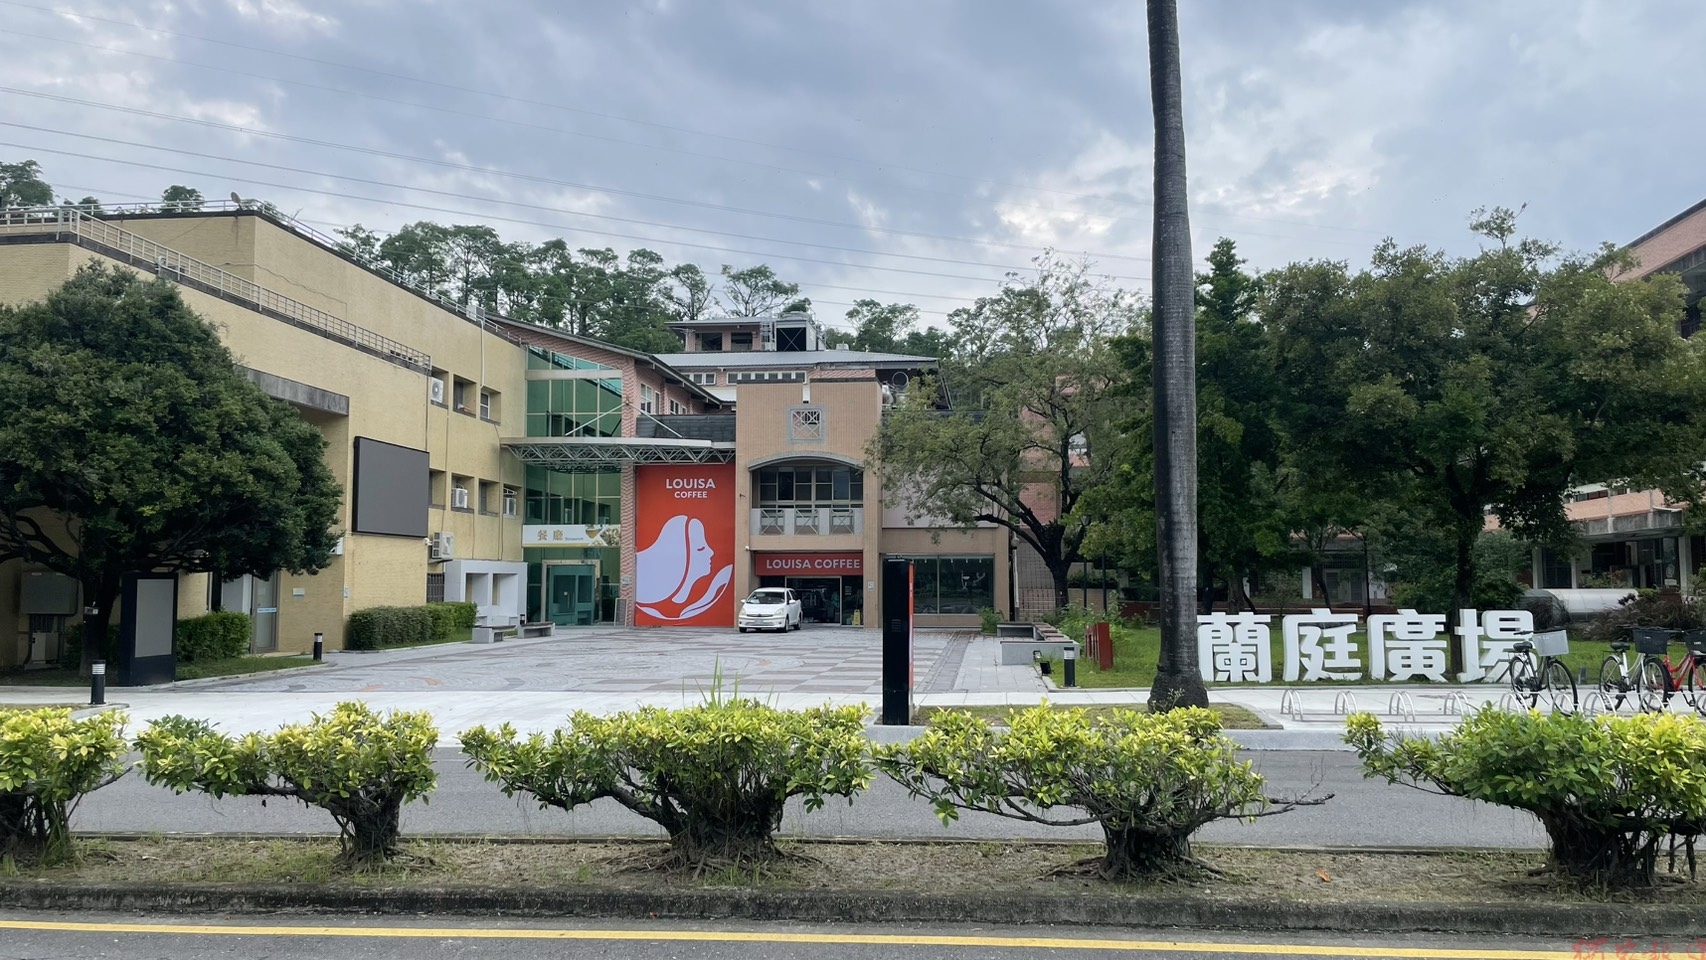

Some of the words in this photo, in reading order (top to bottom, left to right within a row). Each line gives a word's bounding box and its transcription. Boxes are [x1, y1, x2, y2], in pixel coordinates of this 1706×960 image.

[666, 478, 716, 489] LOUISA
[674, 491, 708, 499] COFFEE
[766, 559, 812, 569] LOUISA
[814, 559, 861, 569] COFFEE
[1197, 608, 1538, 684] 蘭庭廣場
